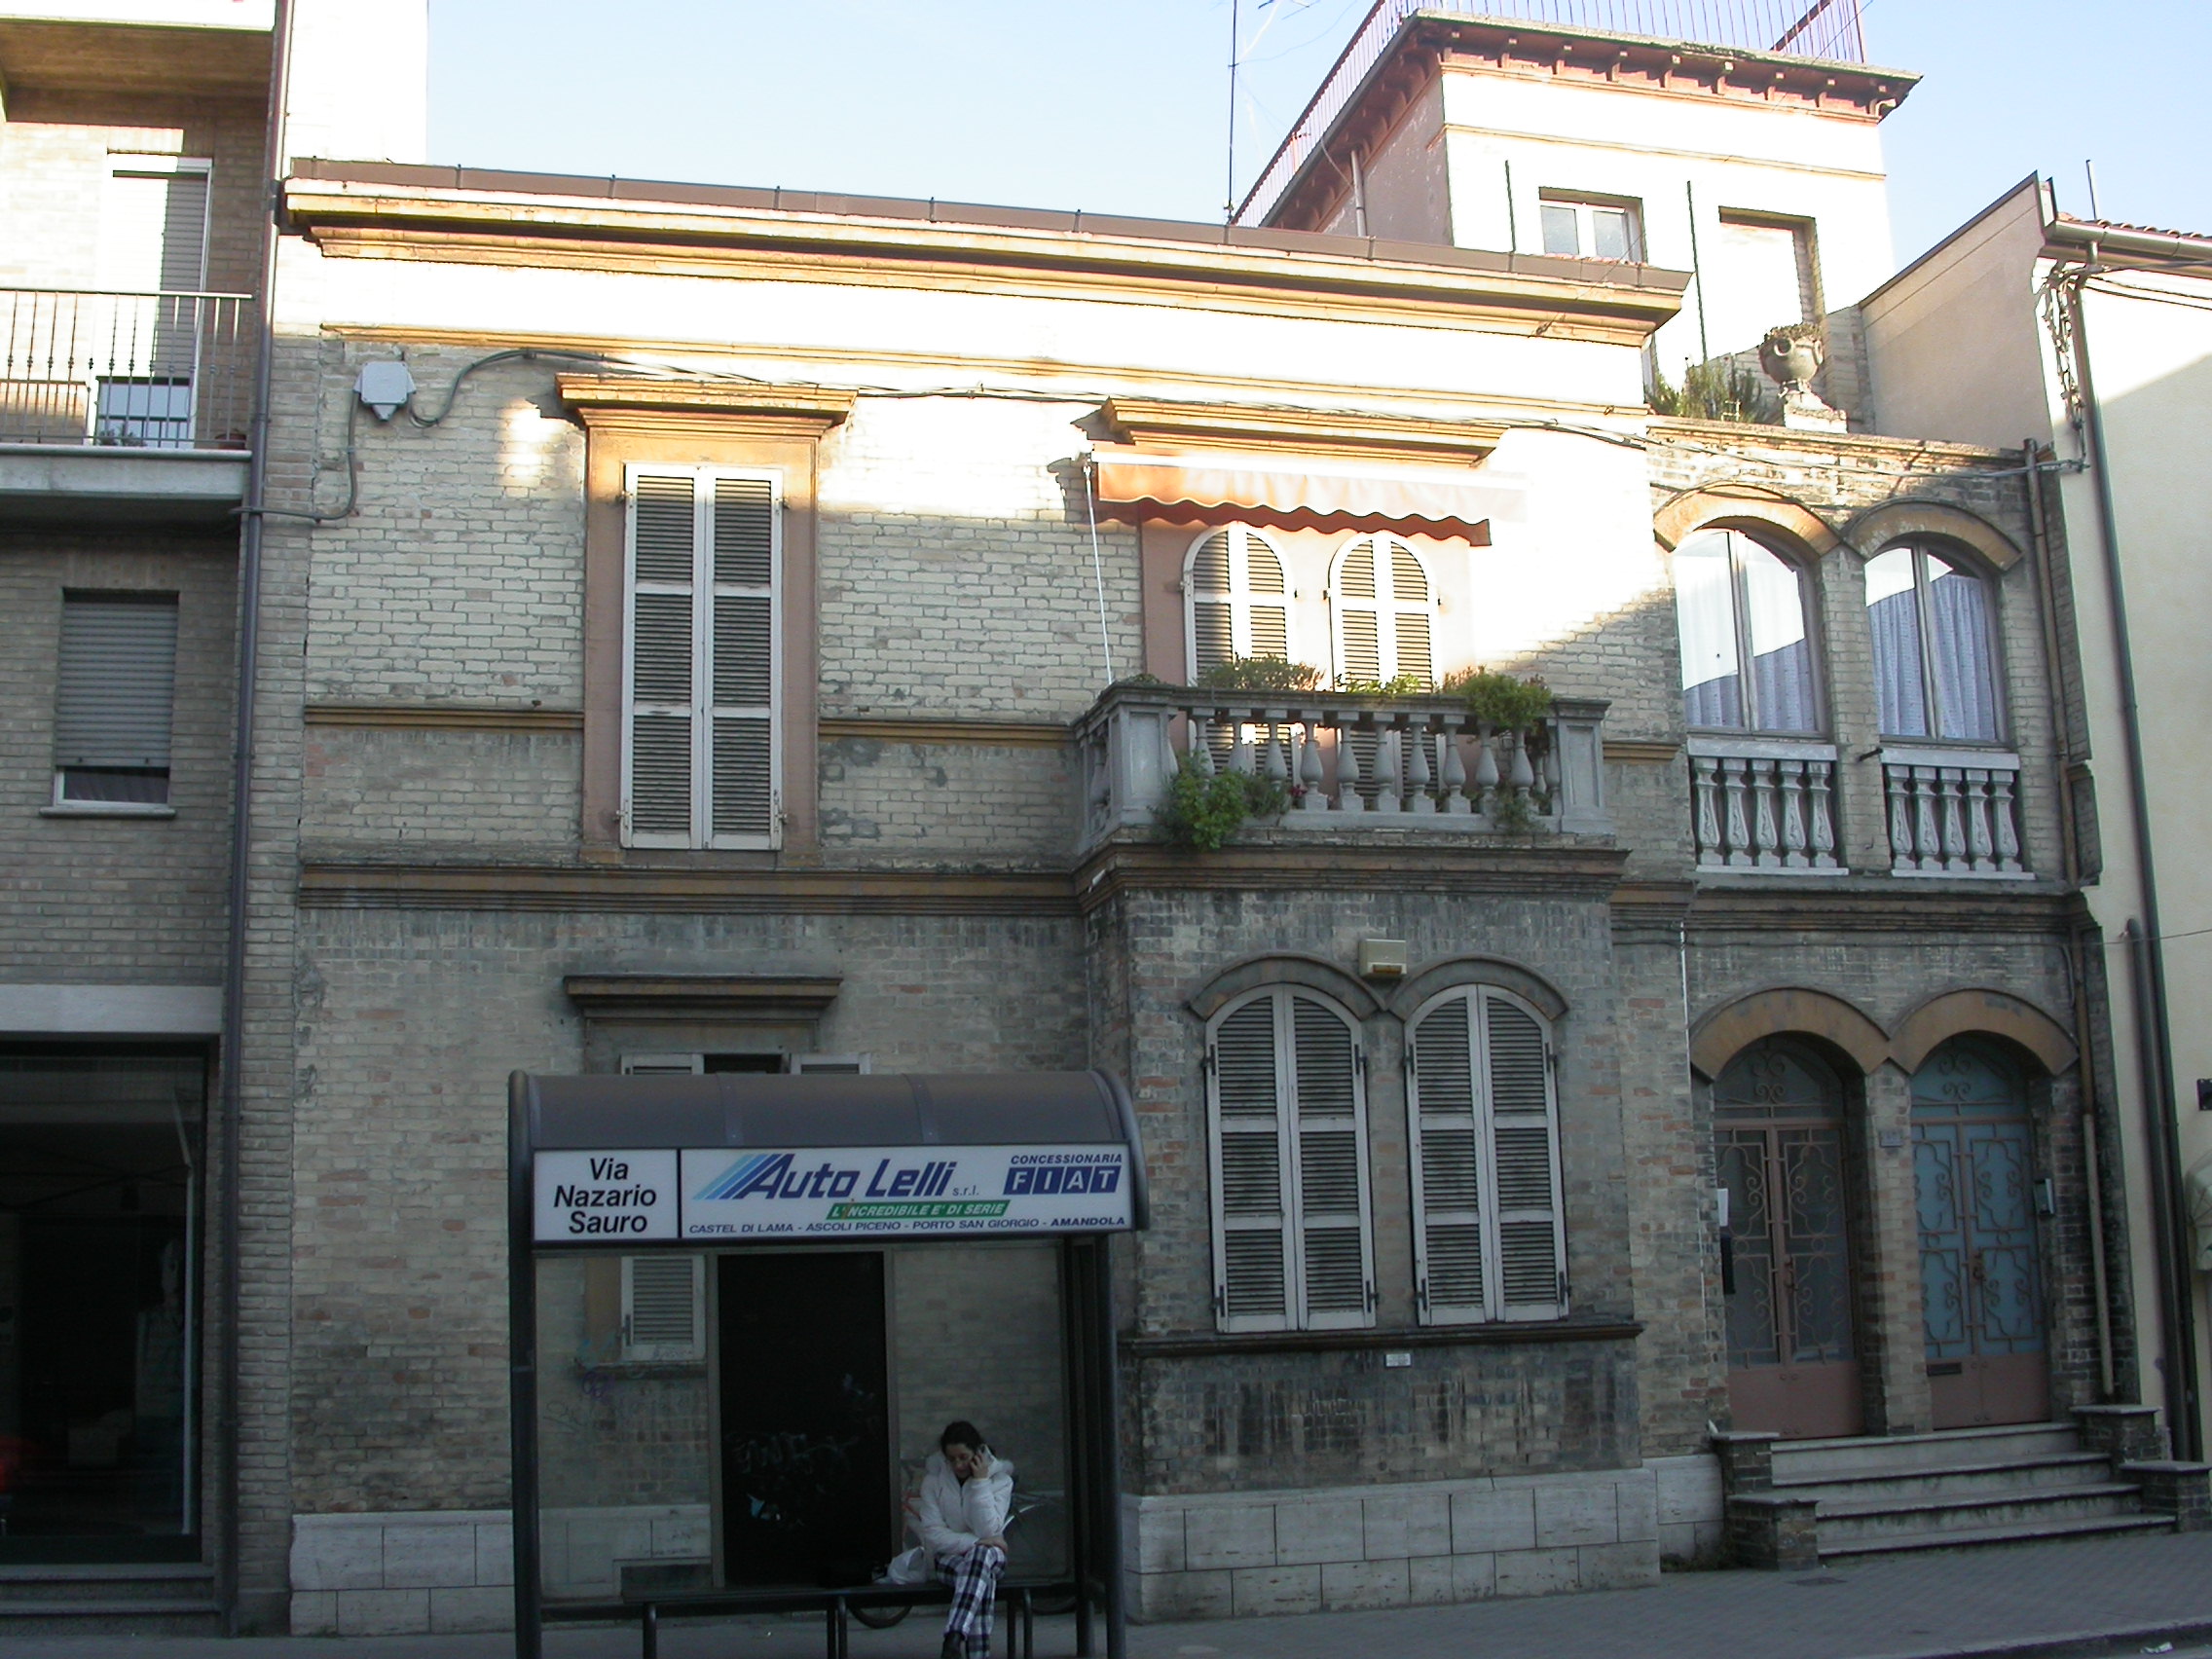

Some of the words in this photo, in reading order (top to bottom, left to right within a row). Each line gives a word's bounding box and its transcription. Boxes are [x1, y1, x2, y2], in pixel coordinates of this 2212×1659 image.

[590, 1158, 629, 1180] Via
[1011, 1154, 1123, 1164] CONCESSIONARIA
[732, 1154, 861, 1198] Auto
[866, 1159, 957, 1197] Lelli
[952, 1185, 979, 1197] s.r.l.
[1010, 1168, 1117, 1193] FIAT
[553, 1184, 657, 1207] Nazario
[831, 1204, 930, 1217] L'NCREDIBILE
[946, 1203, 961, 1215] DI
[964, 1202, 1005, 1214] SERIE
[569, 1210, 647, 1234] Sauro
[689, 1224, 736, 1234] CASTEL
[741, 1224, 755, 1233] DI
[757, 1223, 793, 1232] LAMA
[805, 1222, 852, 1232] ASCOLI
[855, 1221, 901, 1231] PICENO
[912, 1220, 955, 1230] PORTO
[959, 1219, 984, 1229] SAN
[987, 1218, 1039, 1229] GIORGIO
[1051, 1217, 1125, 1227] AMANDOLA
